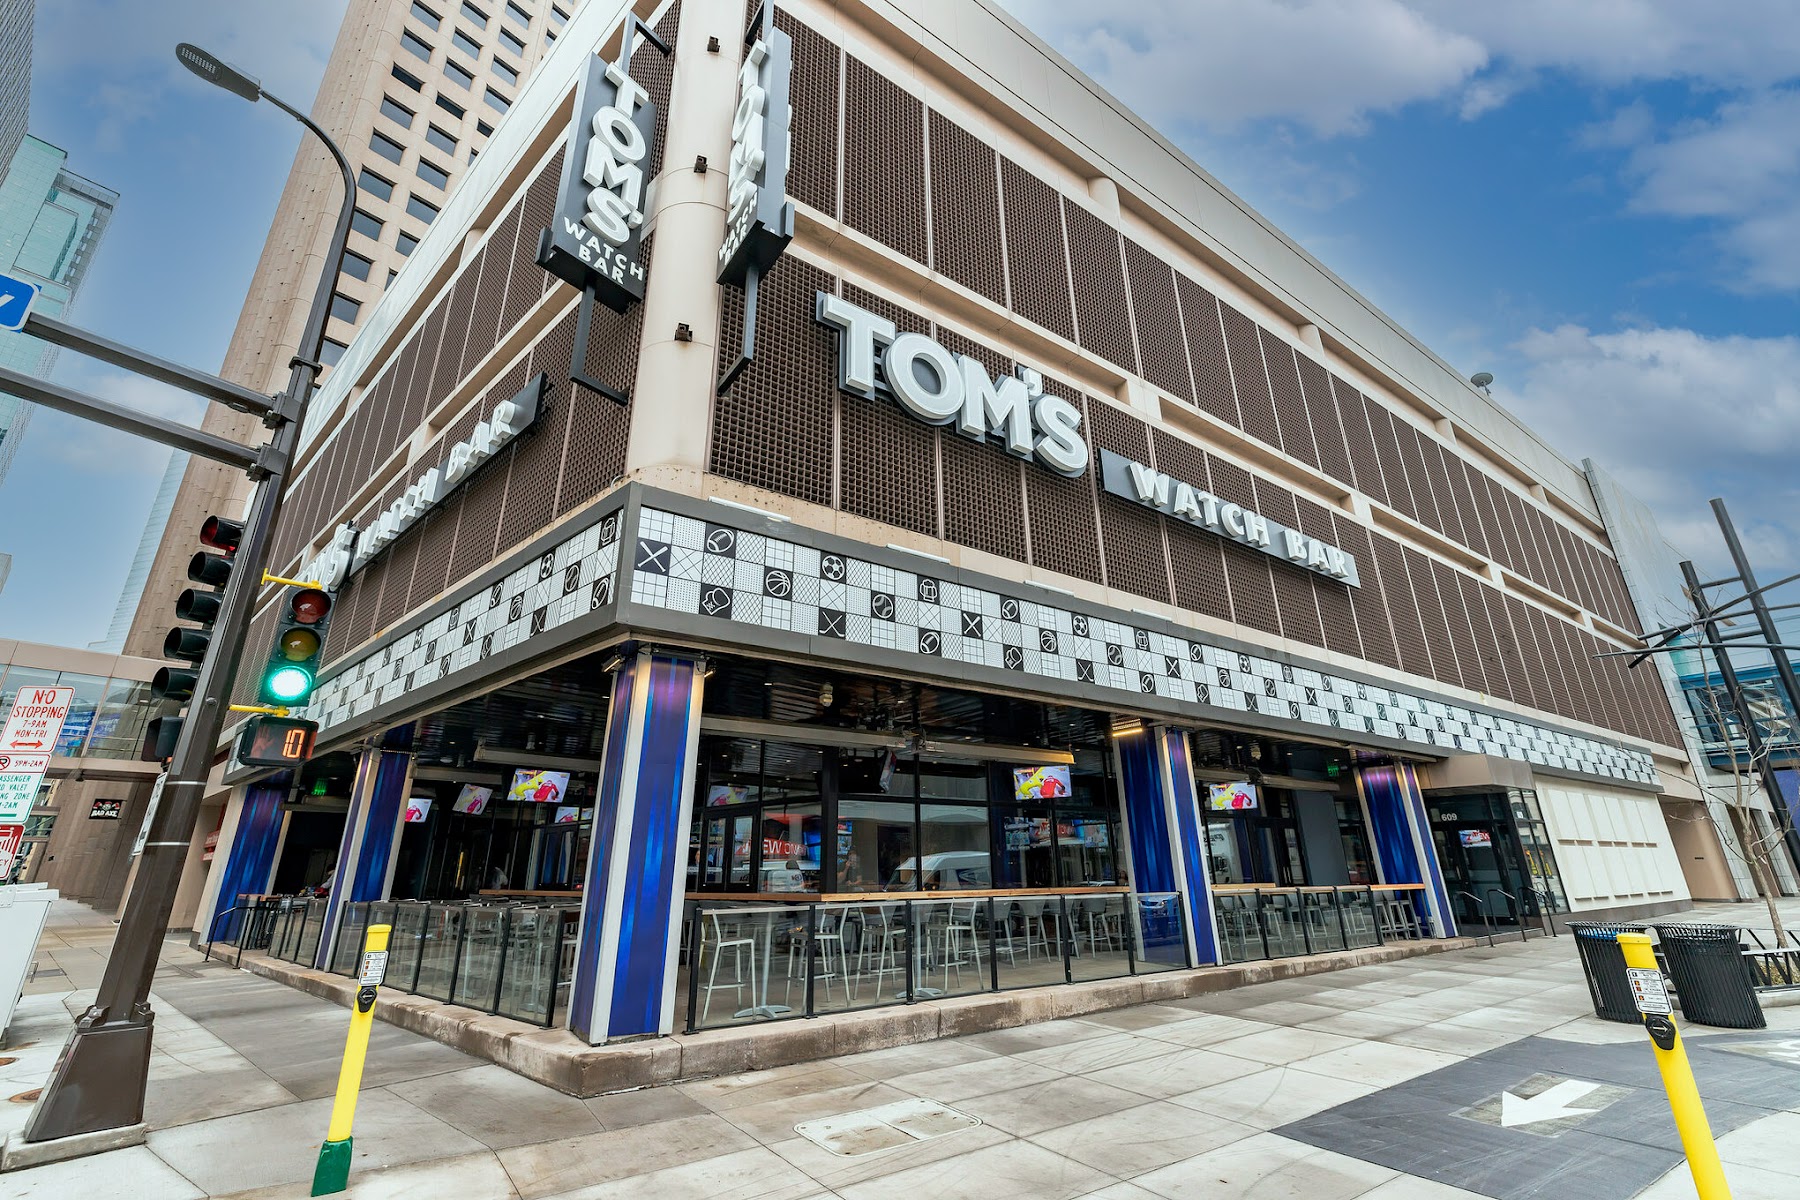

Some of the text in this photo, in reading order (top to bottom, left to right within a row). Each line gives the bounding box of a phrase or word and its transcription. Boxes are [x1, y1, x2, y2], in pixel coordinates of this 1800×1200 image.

[581, 61, 650, 248] TOM'S
[718, 191, 758, 261] WATCH
[564, 216, 645, 282] WATCH
[724, 223, 748, 266] BAR
[578, 243, 625, 285] BAR
[444, 399, 516, 484] BAR
[820, 291, 1350, 579] TOM'S WATCH BAR
[32, 689, 57, 705] NO
[13, 705, 65, 719] STOPPING
[22, 719, 48, 728] 7-9AM
[14, 729, 48, 738] MON-FRI
[281, 728, 306, 759] 10
[14, 760, 44, 768] 5PM-2AM
[9, 783, 28, 791] VALET
[13, 792, 31, 800] ZONE
[1441, 812, 1458, 822] 609
